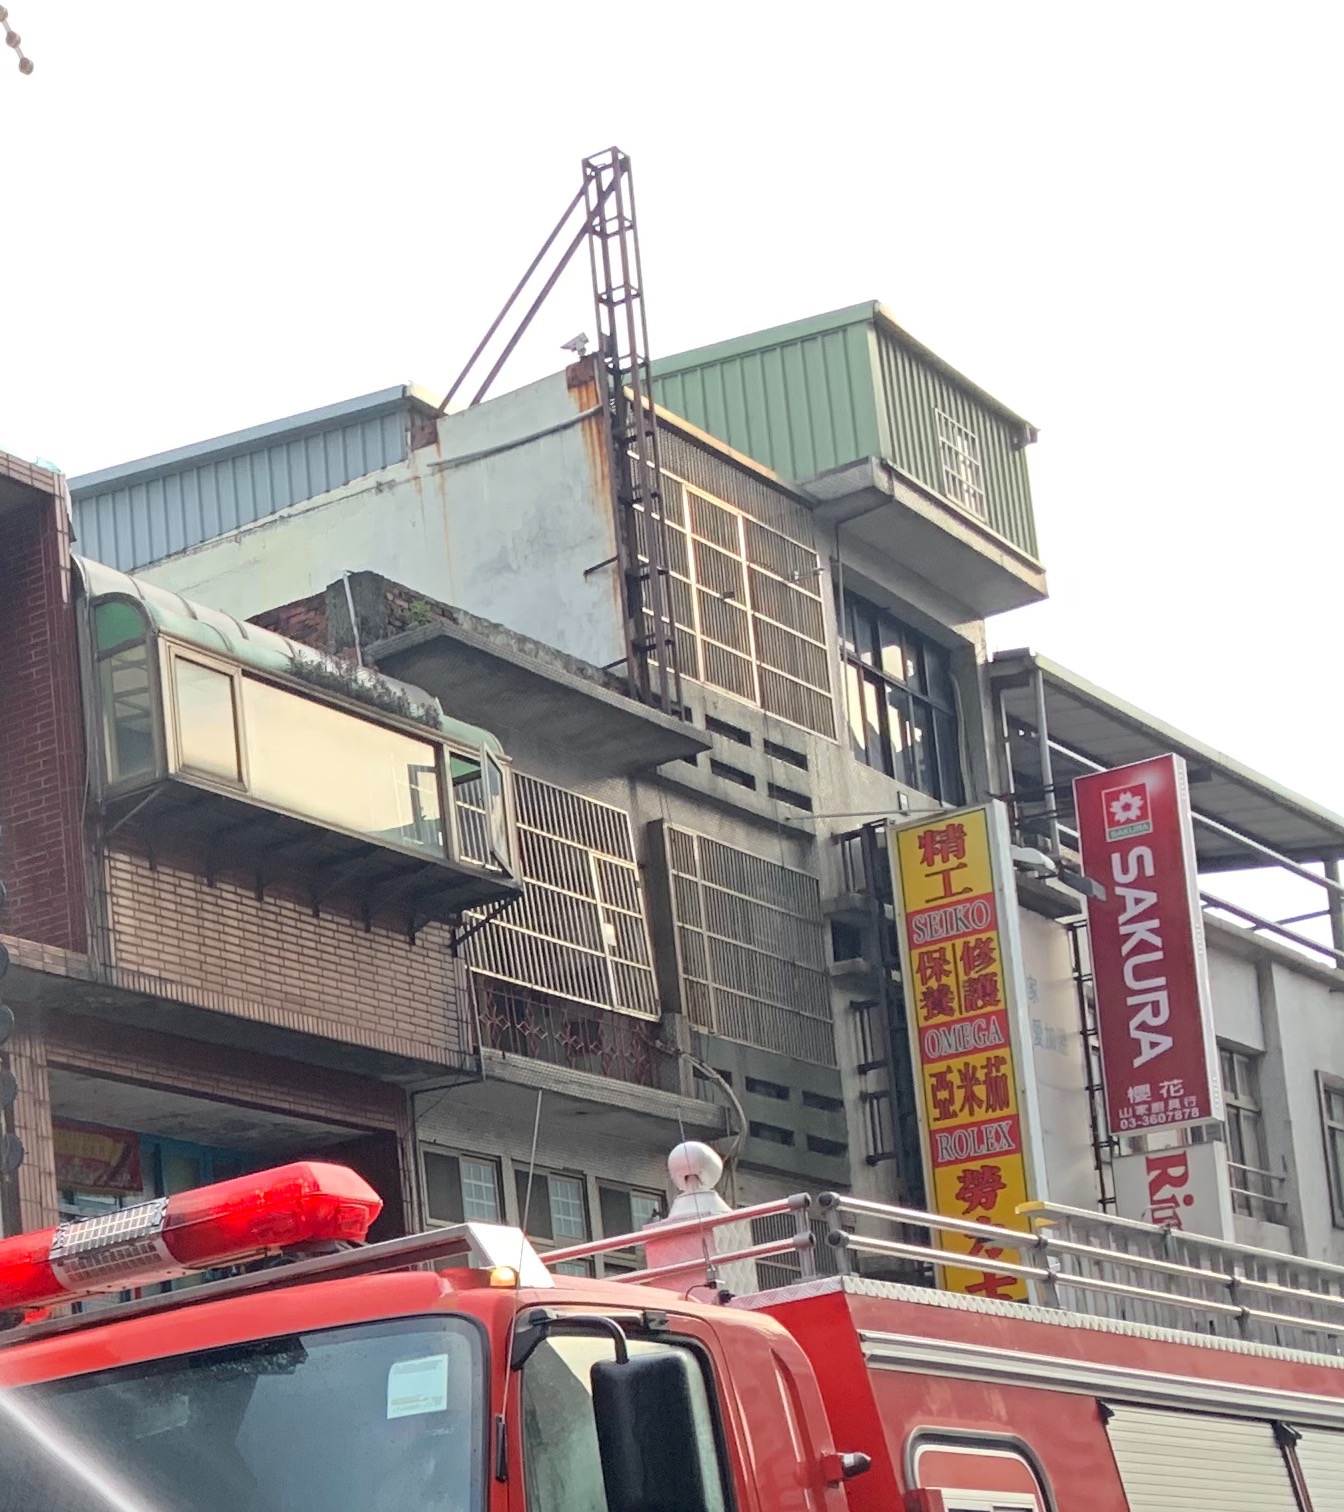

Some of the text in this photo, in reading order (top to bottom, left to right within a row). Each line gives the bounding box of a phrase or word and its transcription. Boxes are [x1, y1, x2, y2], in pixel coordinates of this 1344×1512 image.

[917, 823, 974, 904] 精工
[911, 899, 991, 946] SEIKO
[1110, 845, 1174, 1069] SAKURA
[915, 946, 957, 1022] 保養
[924, 1015, 1005, 1060] OMEGA
[928, 1054, 1011, 1123] 亞米茄
[1126, 1078, 1185, 1104] 櫻花
[1119, 1106, 1200, 1130] 03-3607878
[935, 1119, 1016, 1165] ROLEX
